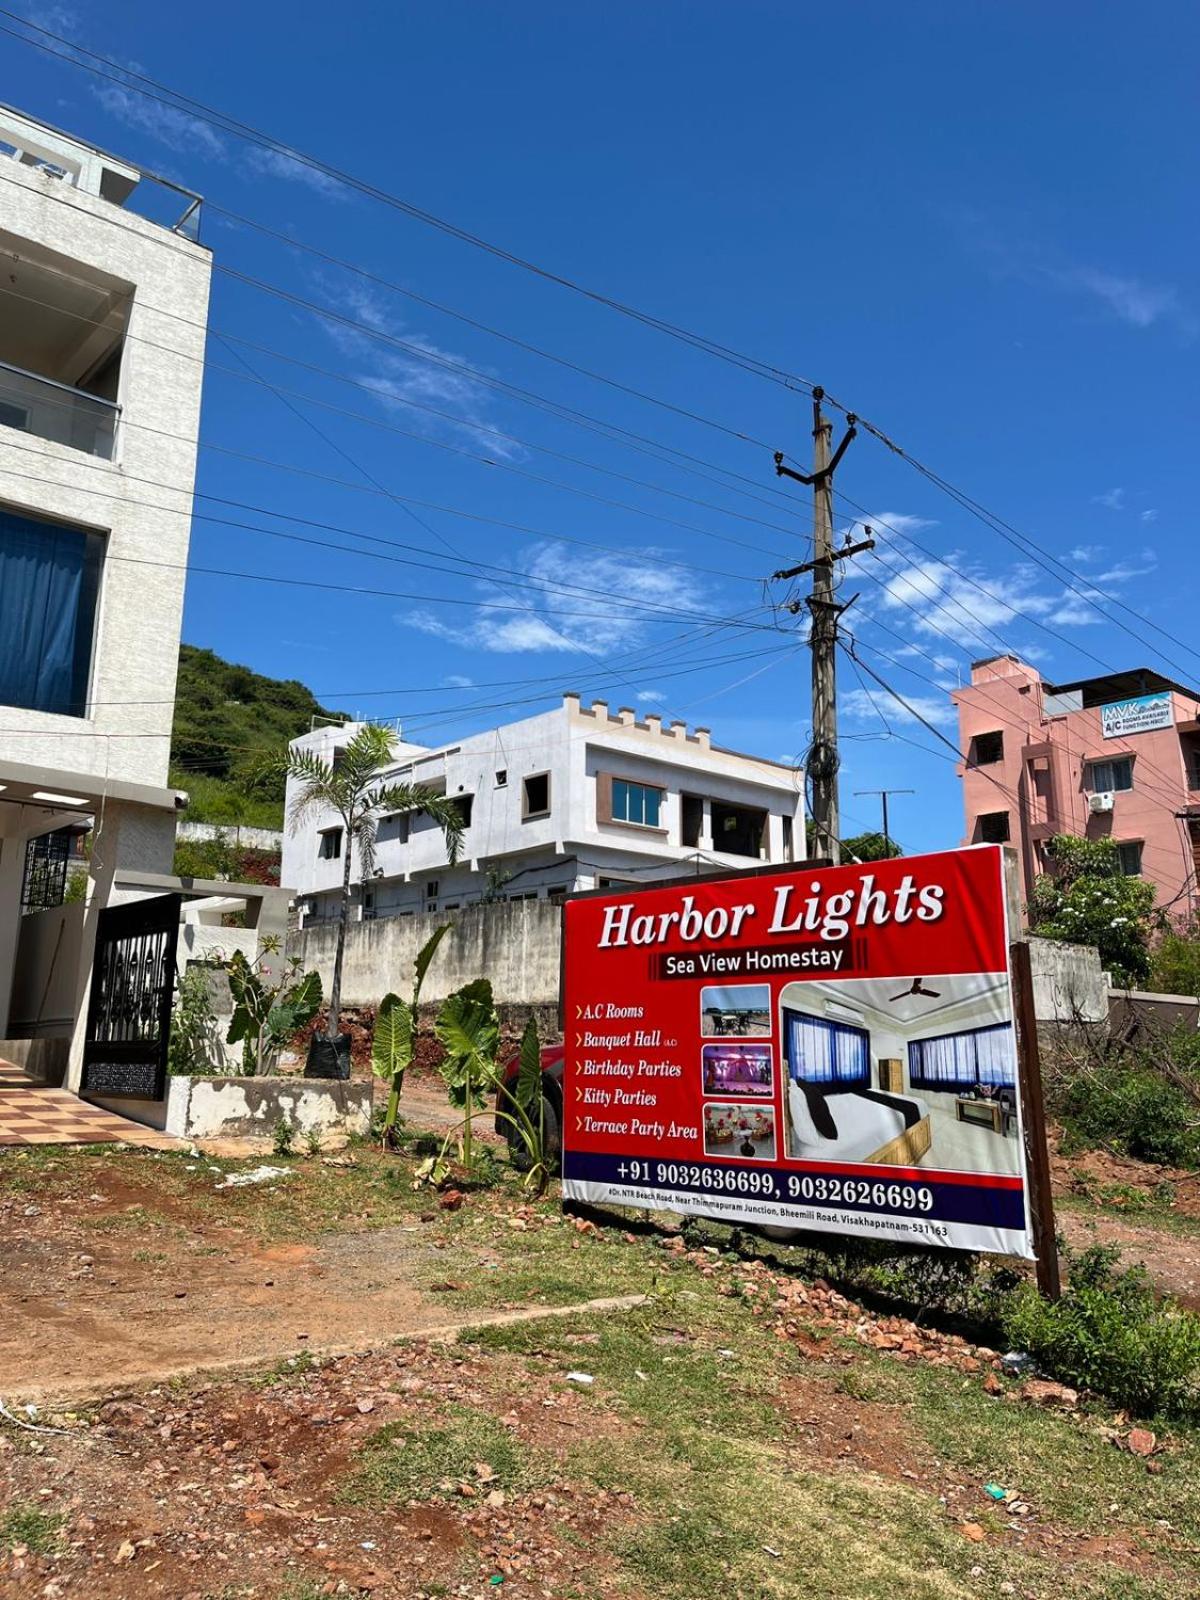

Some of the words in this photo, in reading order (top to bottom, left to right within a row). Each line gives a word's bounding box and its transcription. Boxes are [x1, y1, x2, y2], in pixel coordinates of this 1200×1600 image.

[1104, 702, 1137, 721] MVK
[1123, 716, 1141, 724] ROOMS
[1105, 720, 1121, 732] A/C
[597, 896, 755, 947] Harbor
[767, 874, 944, 941] Lights
[666, 957, 695, 974] Sea
[699, 953, 741, 972] View
[746, 948, 843, 970] Homestay
[583, 1003, 604, 1019] A.C
[606, 1003, 644, 1018] Rooms
[583, 1031, 631, 1051] Banquet
[634, 1030, 661, 1047] Hall
[583, 1060, 635, 1079] Birthday
[637, 1060, 682, 1077] Parties
[583, 1087, 612, 1108] Kitty
[613, 1088, 657, 1106] Parties
[584, 1116, 628, 1134] Terrace
[630, 1118, 665, 1140] Party
[667, 1121, 698, 1139] Area
[617, 1161, 651, 1181] +91
[657, 1163, 780, 1199] 9032636699,
[788, 1175, 933, 1211] 9032626699
[636, 1190, 655, 1200] Beach
[656, 1193, 674, 1203] Road,
[675, 1195, 691, 1204] Near
[692, 1197, 742, 1211] Thimmapuram
[744, 1204, 779, 1216] Junction,
[816, 1211, 839, 1223] Road,
